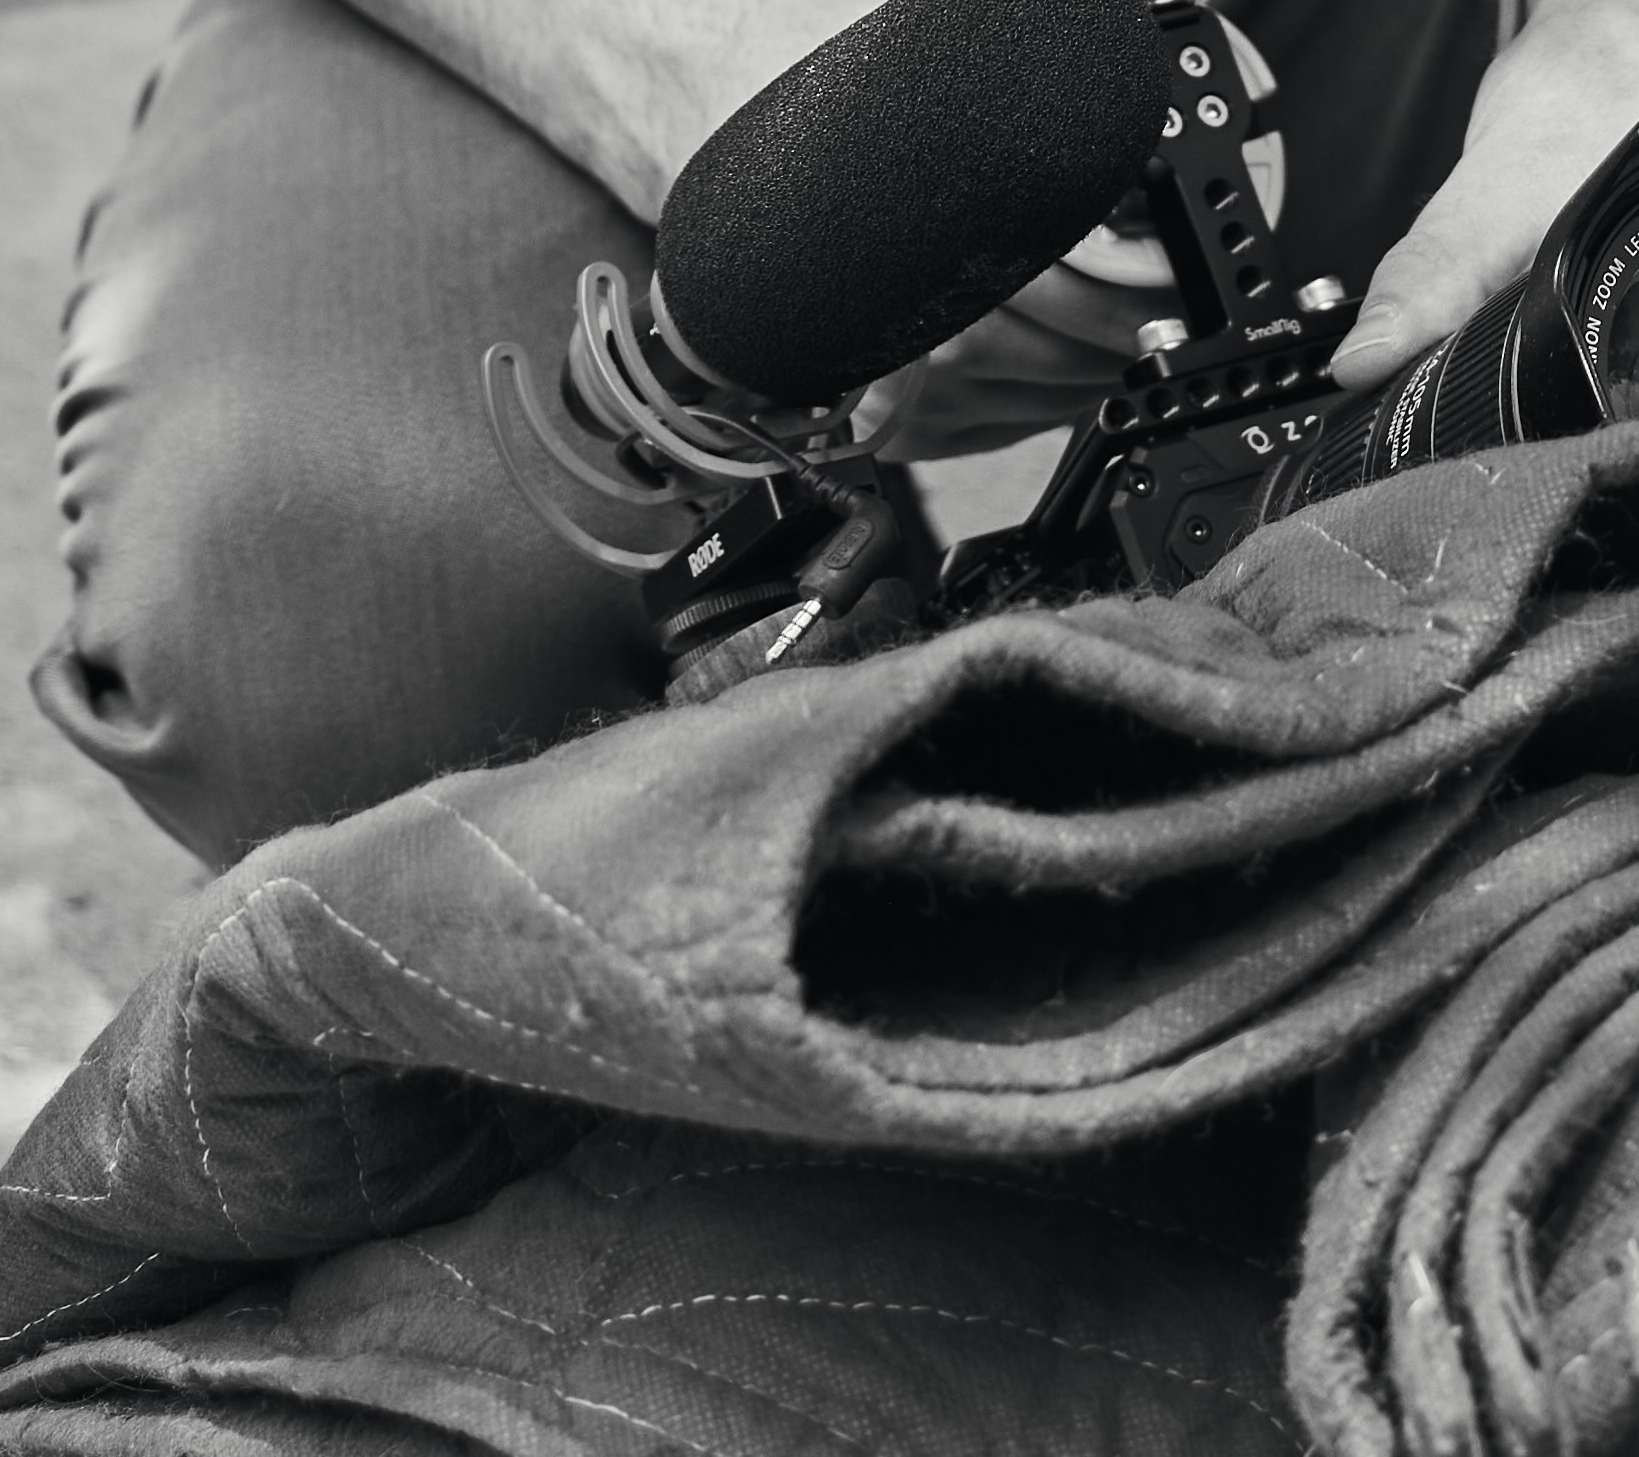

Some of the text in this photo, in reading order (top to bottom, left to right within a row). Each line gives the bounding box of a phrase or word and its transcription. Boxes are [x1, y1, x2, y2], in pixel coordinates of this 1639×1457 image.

[1592, 257, 1626, 311] ZOOM
[1585, 317, 1602, 364] NON
[687, 532, 725, 578] RØDE
